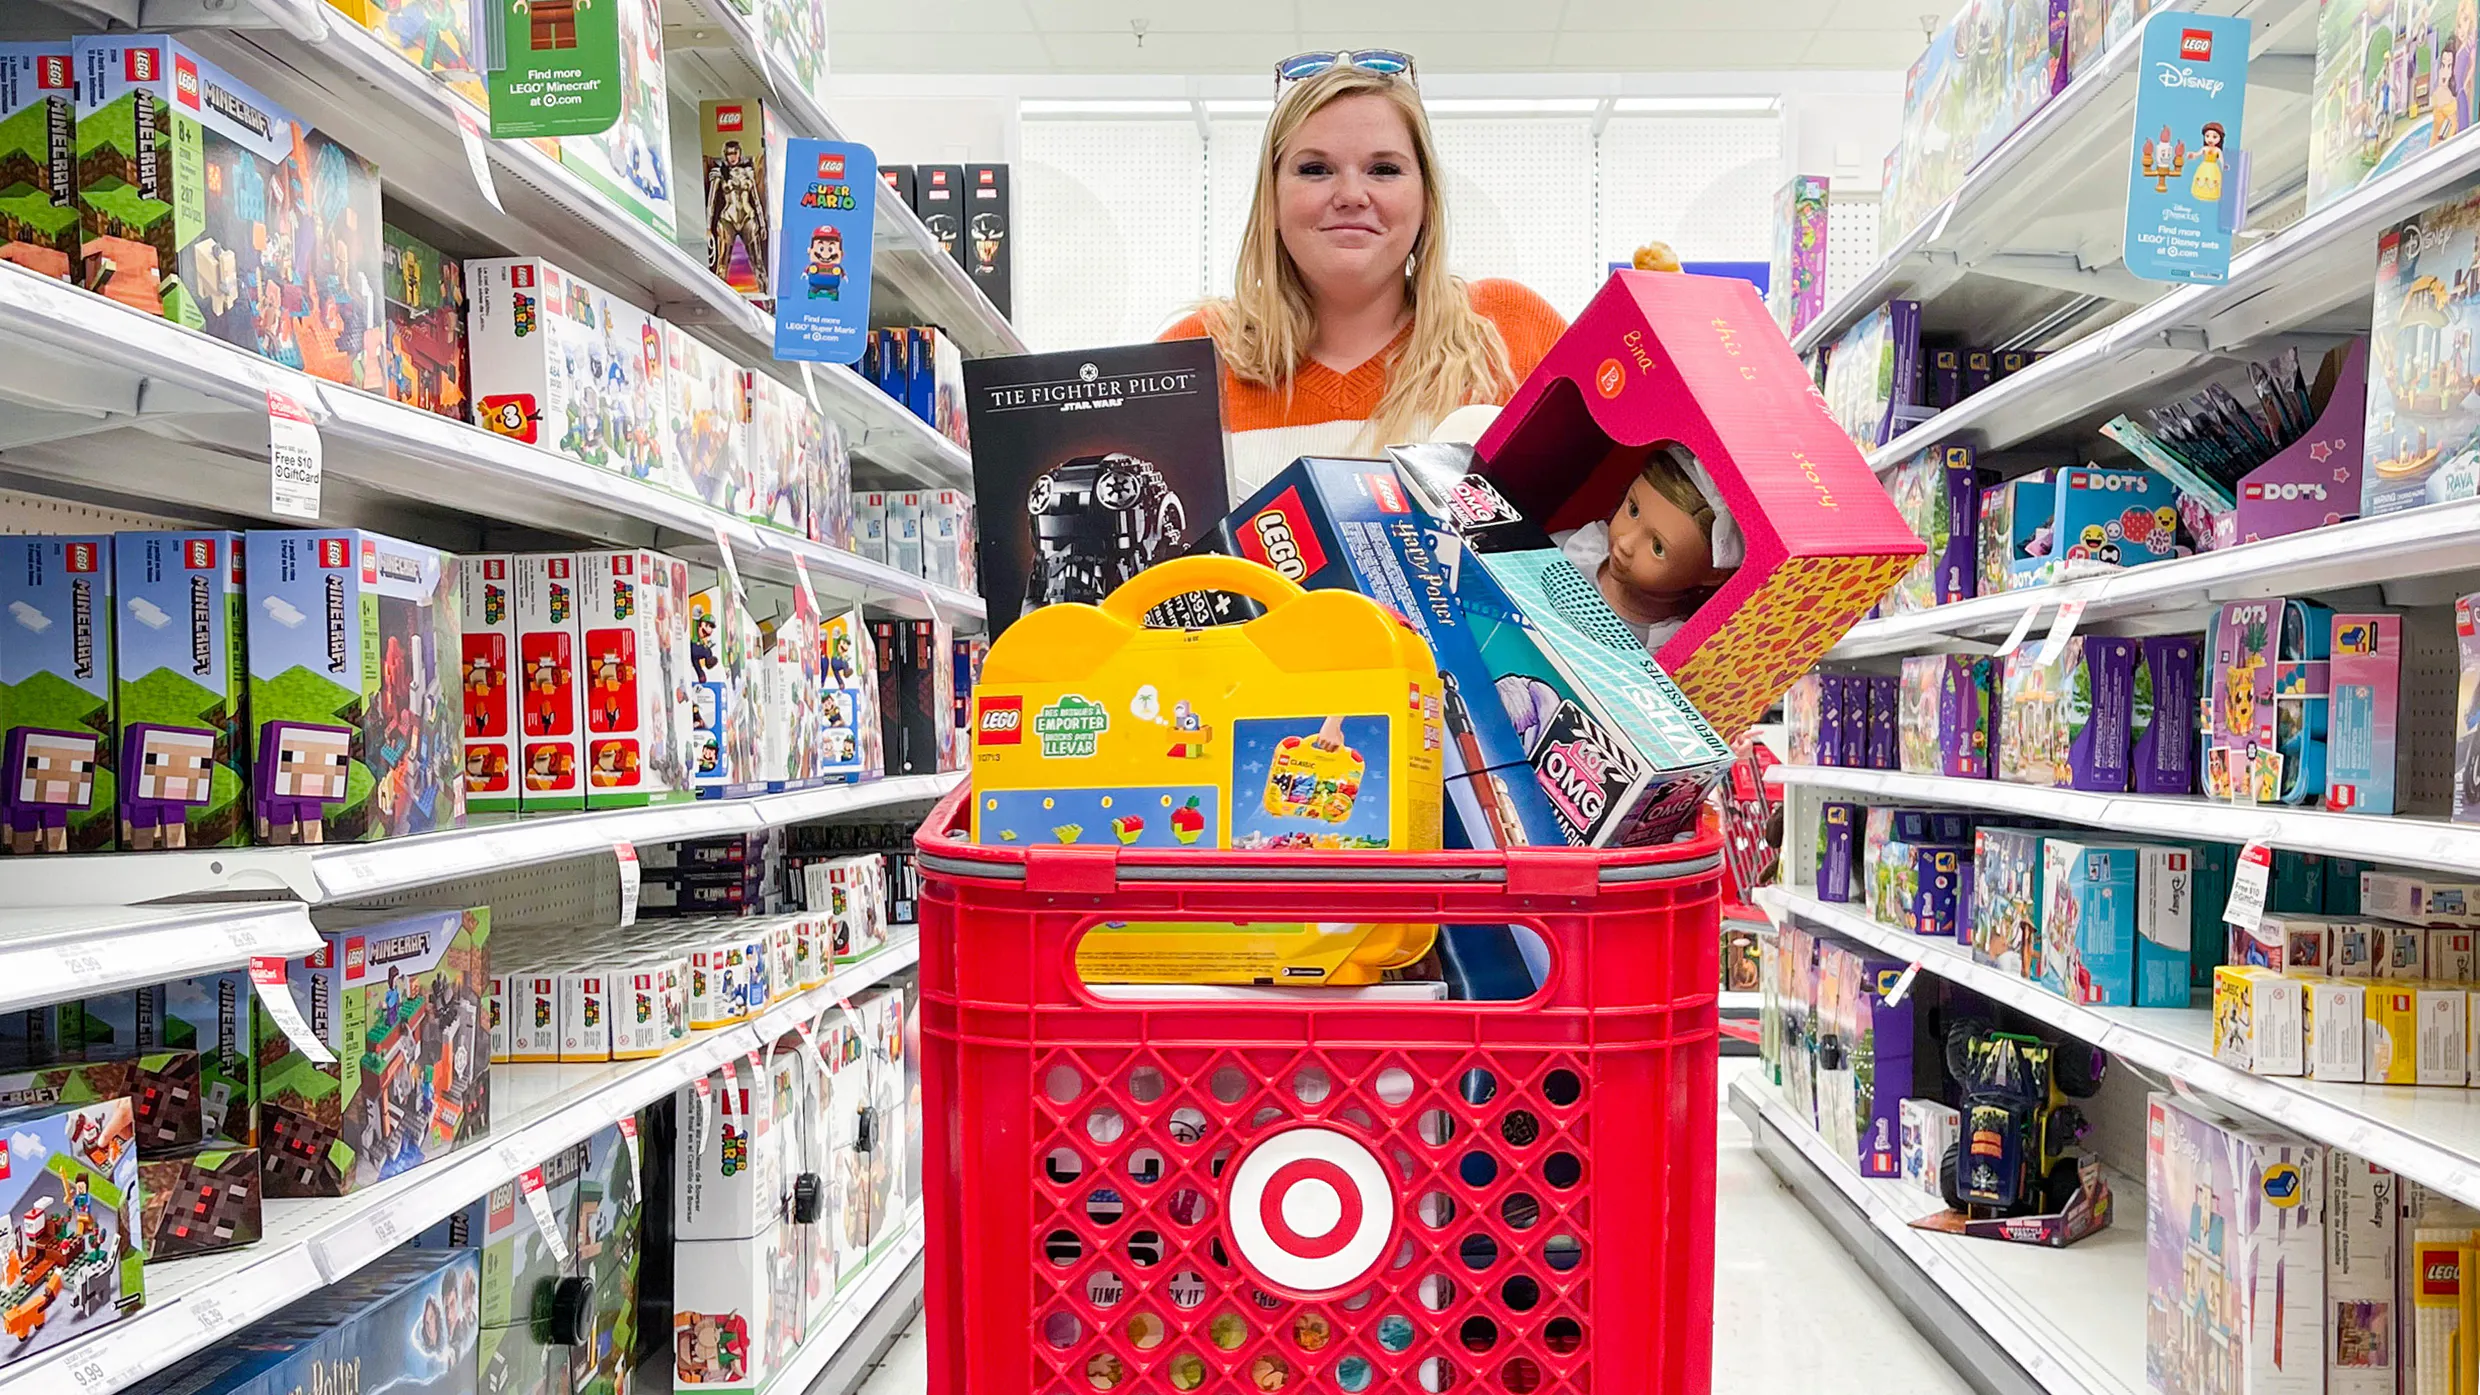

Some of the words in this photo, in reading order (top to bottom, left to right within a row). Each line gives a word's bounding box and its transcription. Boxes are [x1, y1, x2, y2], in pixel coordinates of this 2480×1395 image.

[2184, 39, 2209, 51] LEGO
[49, 56, 63, 87] LEGO
[134, 50, 150, 81] LEGO
[528, 69, 551, 80] Find
[553, 69, 582, 79] more
[178, 69, 198, 96] LEGO
[204, 79, 273, 142] MINECRAFT
[530, 97, 541, 106] at
[718, 112, 741, 124] LEGO
[47, 94, 70, 208] MINECRAFT
[134, 87, 158, 201] MINECRAFT
[819, 160, 844, 172] LEGO
[800, 192, 857, 211] MARIO
[808, 182, 851, 197] SUPER
[2158, 224, 2177, 234] Find
[2178, 228, 2201, 237] more
[2170, 237, 2200, 249] Disney
[2201, 241, 2219, 250] sets
[2157, 247, 2166, 255] at
[518, 266, 528, 287] LEGO
[513, 292, 527, 337] MARIO
[526, 297, 537, 332] SUPER
[803, 314, 820, 323] Find
[820, 317, 841, 325] more
[810, 324, 833, 334] Super
[1624, 330, 1653, 376] Bina
[1711, 317, 1740, 357] this
[1740, 366, 1756, 380] is
[991, 390, 1026, 406] TIE
[1031, 381, 1123, 402] FIGHTER
[1129, 375, 1189, 394] PILOT
[1060, 401, 1092, 412] STAR
[1093, 398, 1124, 410] WARS
[275, 452, 295, 466] Free
[297, 456, 312, 469] $10
[284, 466, 319, 484] GiftCard
[1791, 451, 1838, 509] story
[2089, 473, 2148, 493] DOTS
[2445, 472, 2474, 492] RAYA
[1375, 475, 1401, 511] LEGO
[2263, 483, 2327, 500] DOTS
[75, 545, 89, 571] LEGO
[193, 541, 207, 567] LEGO
[327, 540, 341, 567] LEGO
[1256, 511, 1305, 581] LEGO
[379, 552, 422, 584] MINECRAFT
[1390, 519, 1430, 572] Harry
[1418, 573, 1456, 627] Potter
[485, 583, 497, 625] MARIO
[550, 582, 562, 624] MARIO
[614, 579, 626, 620] MARIO
[72, 578, 93, 679] MINECRAFT
[190, 574, 211, 676] MINECRAFT
[326, 573, 346, 674] MINECRAFT
[2231, 606, 2268, 625] DOTS
[1640, 660, 1697, 722] CASSETTES
[982, 711, 1019, 728] LEGO
[1038, 717, 1104, 731] EMPORTER
[1632, 688, 1702, 758] VHS
[1045, 741, 1094, 754] LLEVAR
[1695, 723, 1728, 757] VIDEO
[1290, 759, 1316, 769] CLASSIC
[2235, 881, 2248, 893] Free
[347, 948, 364, 966] LEGO
[369, 932, 431, 966] MINECRAFT
[2222, 981, 2240, 996] CLASSIC
[219, 978, 235, 1076] MINECRAFT
[721, 1123, 737, 1176] MARIO
[74, 1363, 104, 1386] 9.99
[311, 1355, 361, 1395] Potter
